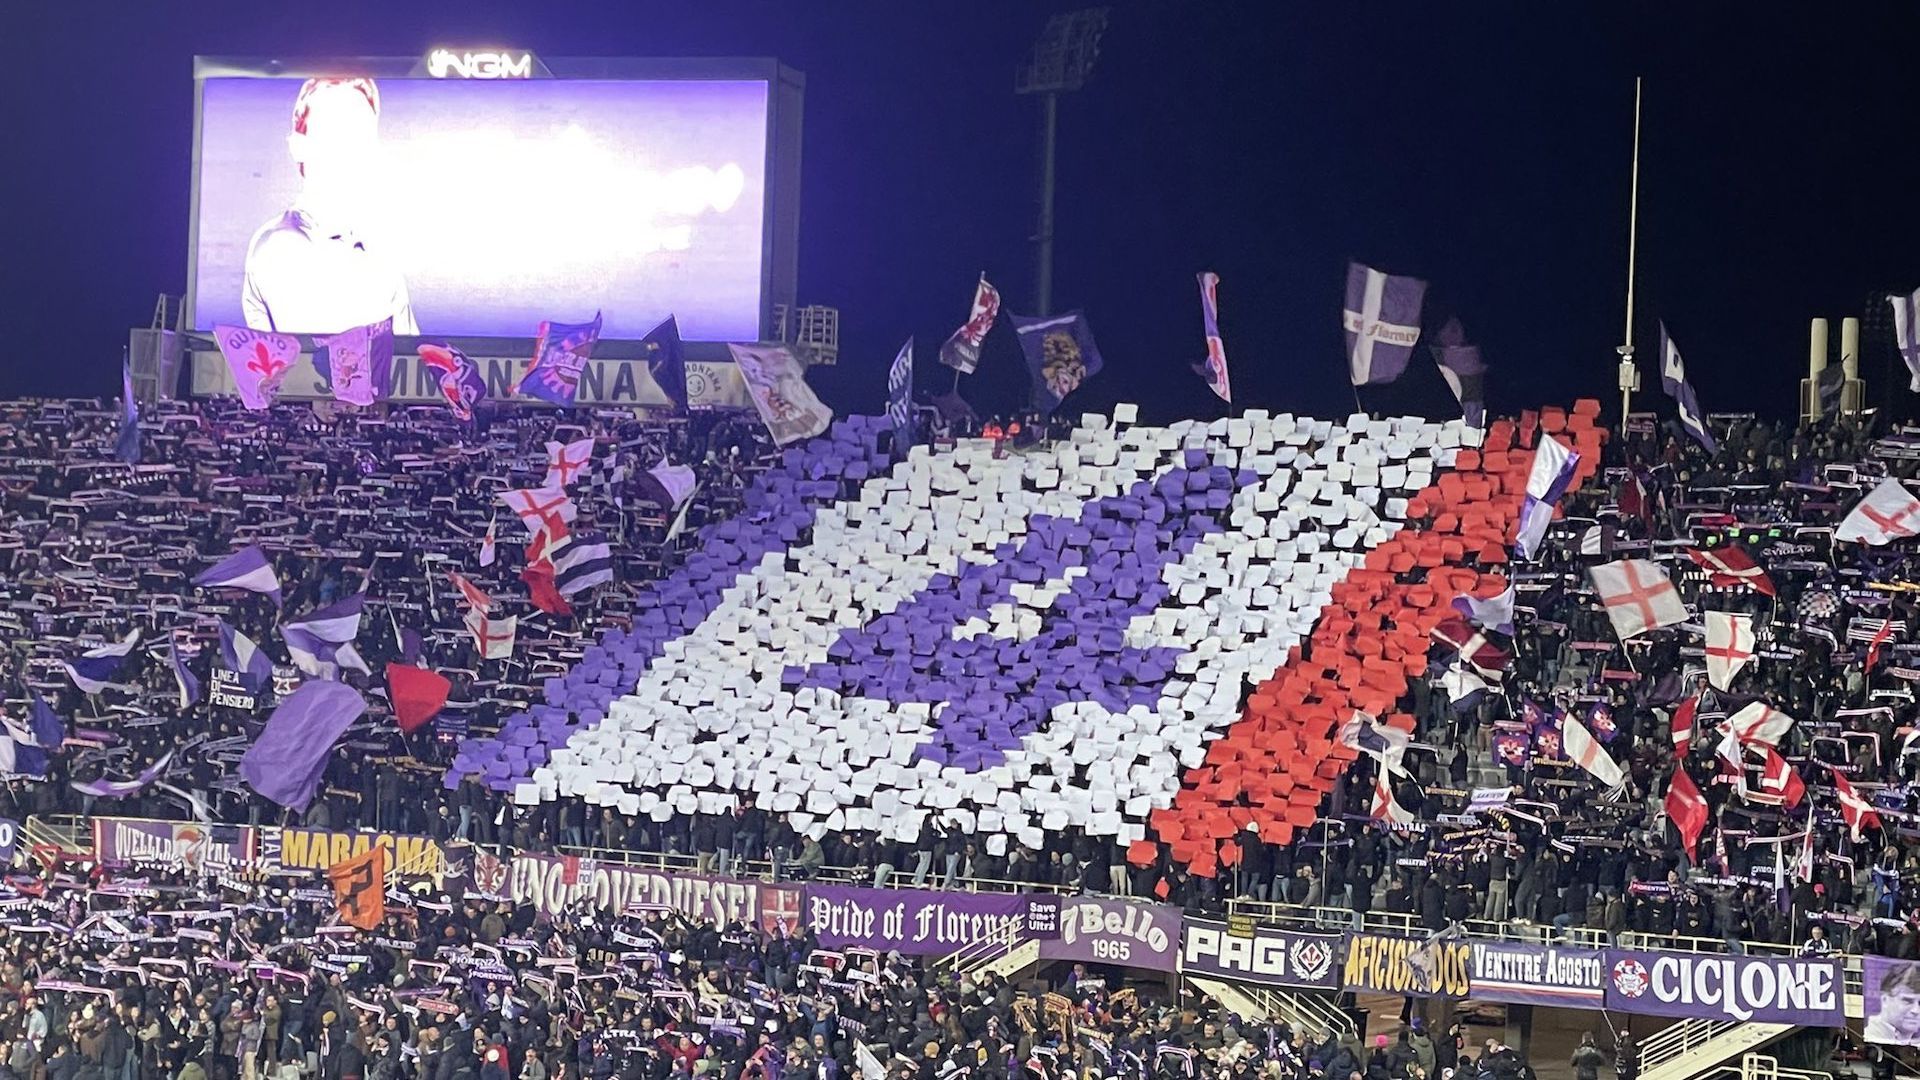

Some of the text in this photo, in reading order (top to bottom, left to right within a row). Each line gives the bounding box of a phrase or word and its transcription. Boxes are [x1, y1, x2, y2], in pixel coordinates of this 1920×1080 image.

[430, 50, 532, 79] NGM
[211, 667, 240, 684] LINEA
[211, 680, 221, 692] DI
[209, 691, 255, 710] PENSIERO
[808, 895, 876, 938] Pride
[882, 902, 905, 941] of
[1030, 902, 1057, 913] Save
[1091, 938, 1131, 961] 1965
[1186, 926, 1286, 976] PAG
[1344, 935, 1470, 997] AFICIONDOS
[1651, 956, 1836, 1021] CICLONE
[600, 1028, 637, 1039] LTRA
